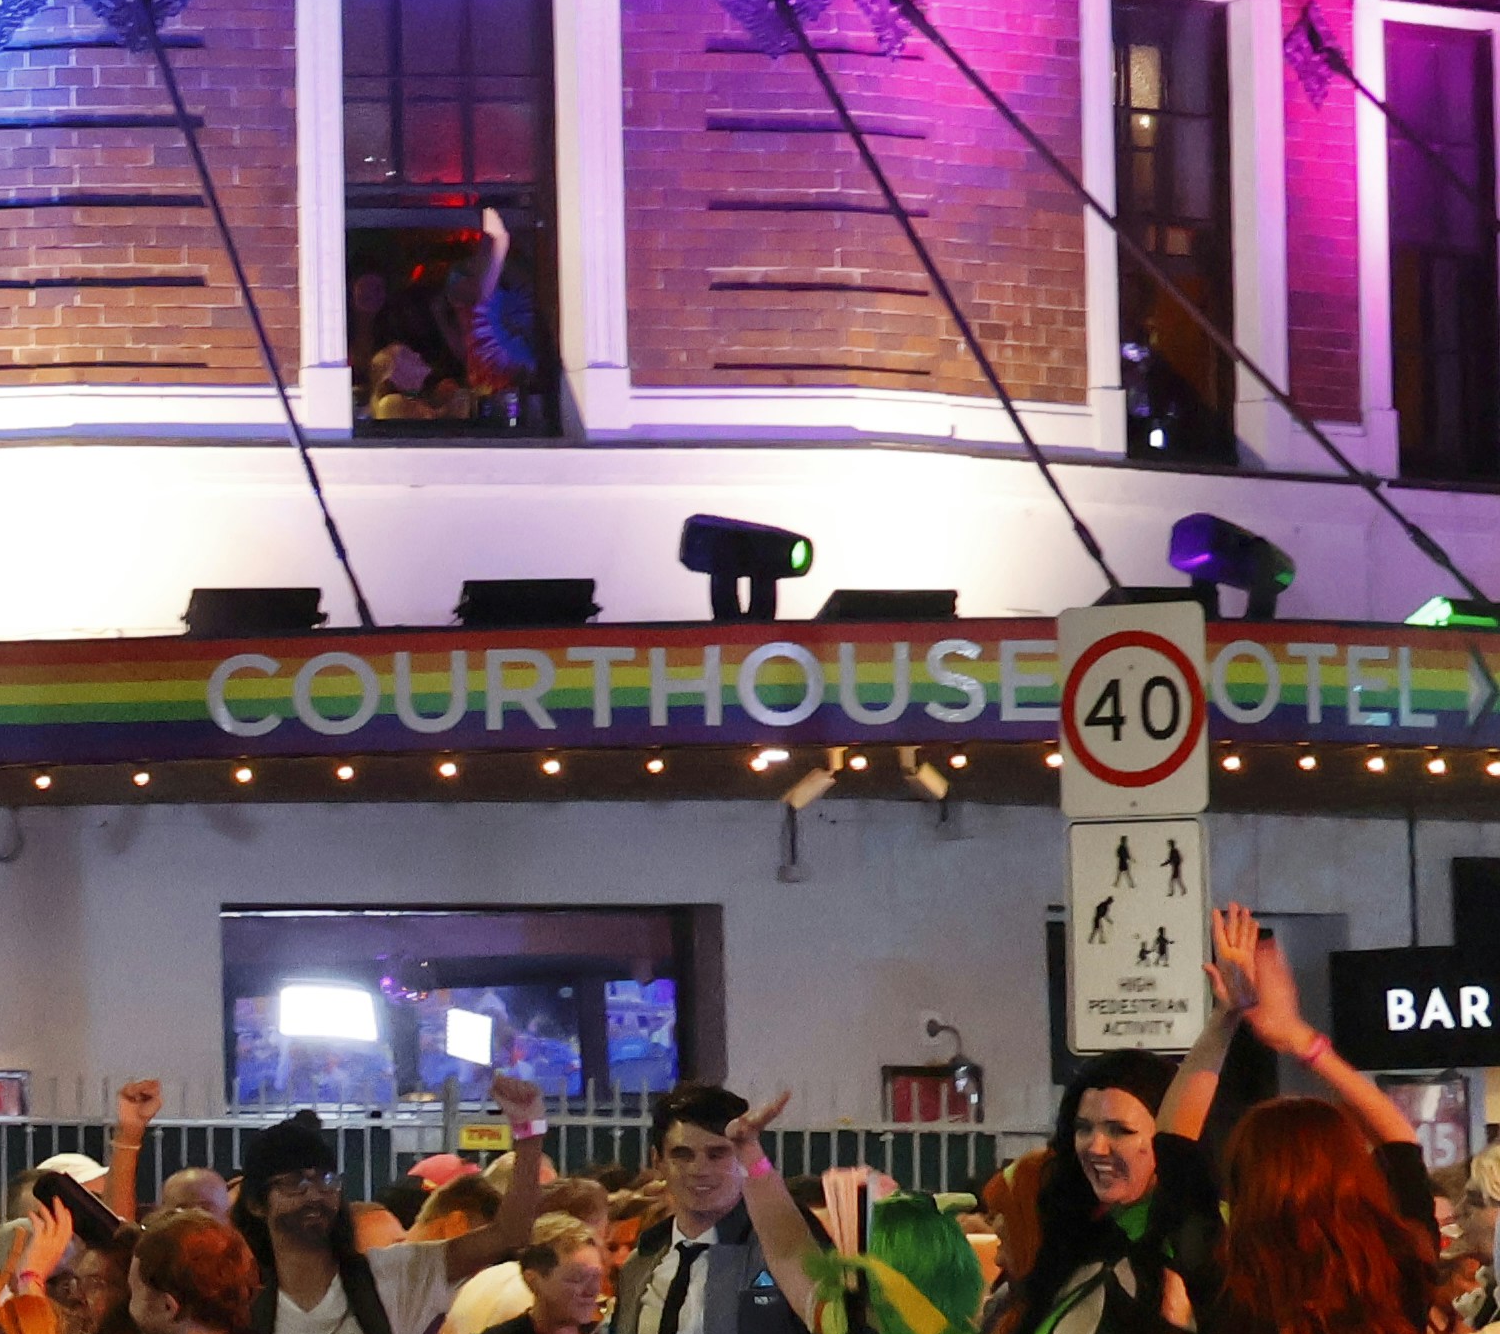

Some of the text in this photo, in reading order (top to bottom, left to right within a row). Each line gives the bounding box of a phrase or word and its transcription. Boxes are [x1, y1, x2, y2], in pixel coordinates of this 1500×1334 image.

[207, 639, 1438, 737] COURTHOUSE OTEL
[1084, 675, 1180, 741] 40
[1118, 976, 1157, 993] HIGH
[1087, 998, 1190, 1016] PEDESTRIAN
[1386, 985, 1493, 1032] BAR
[1101, 1018, 1176, 1036] ACTIVITY
